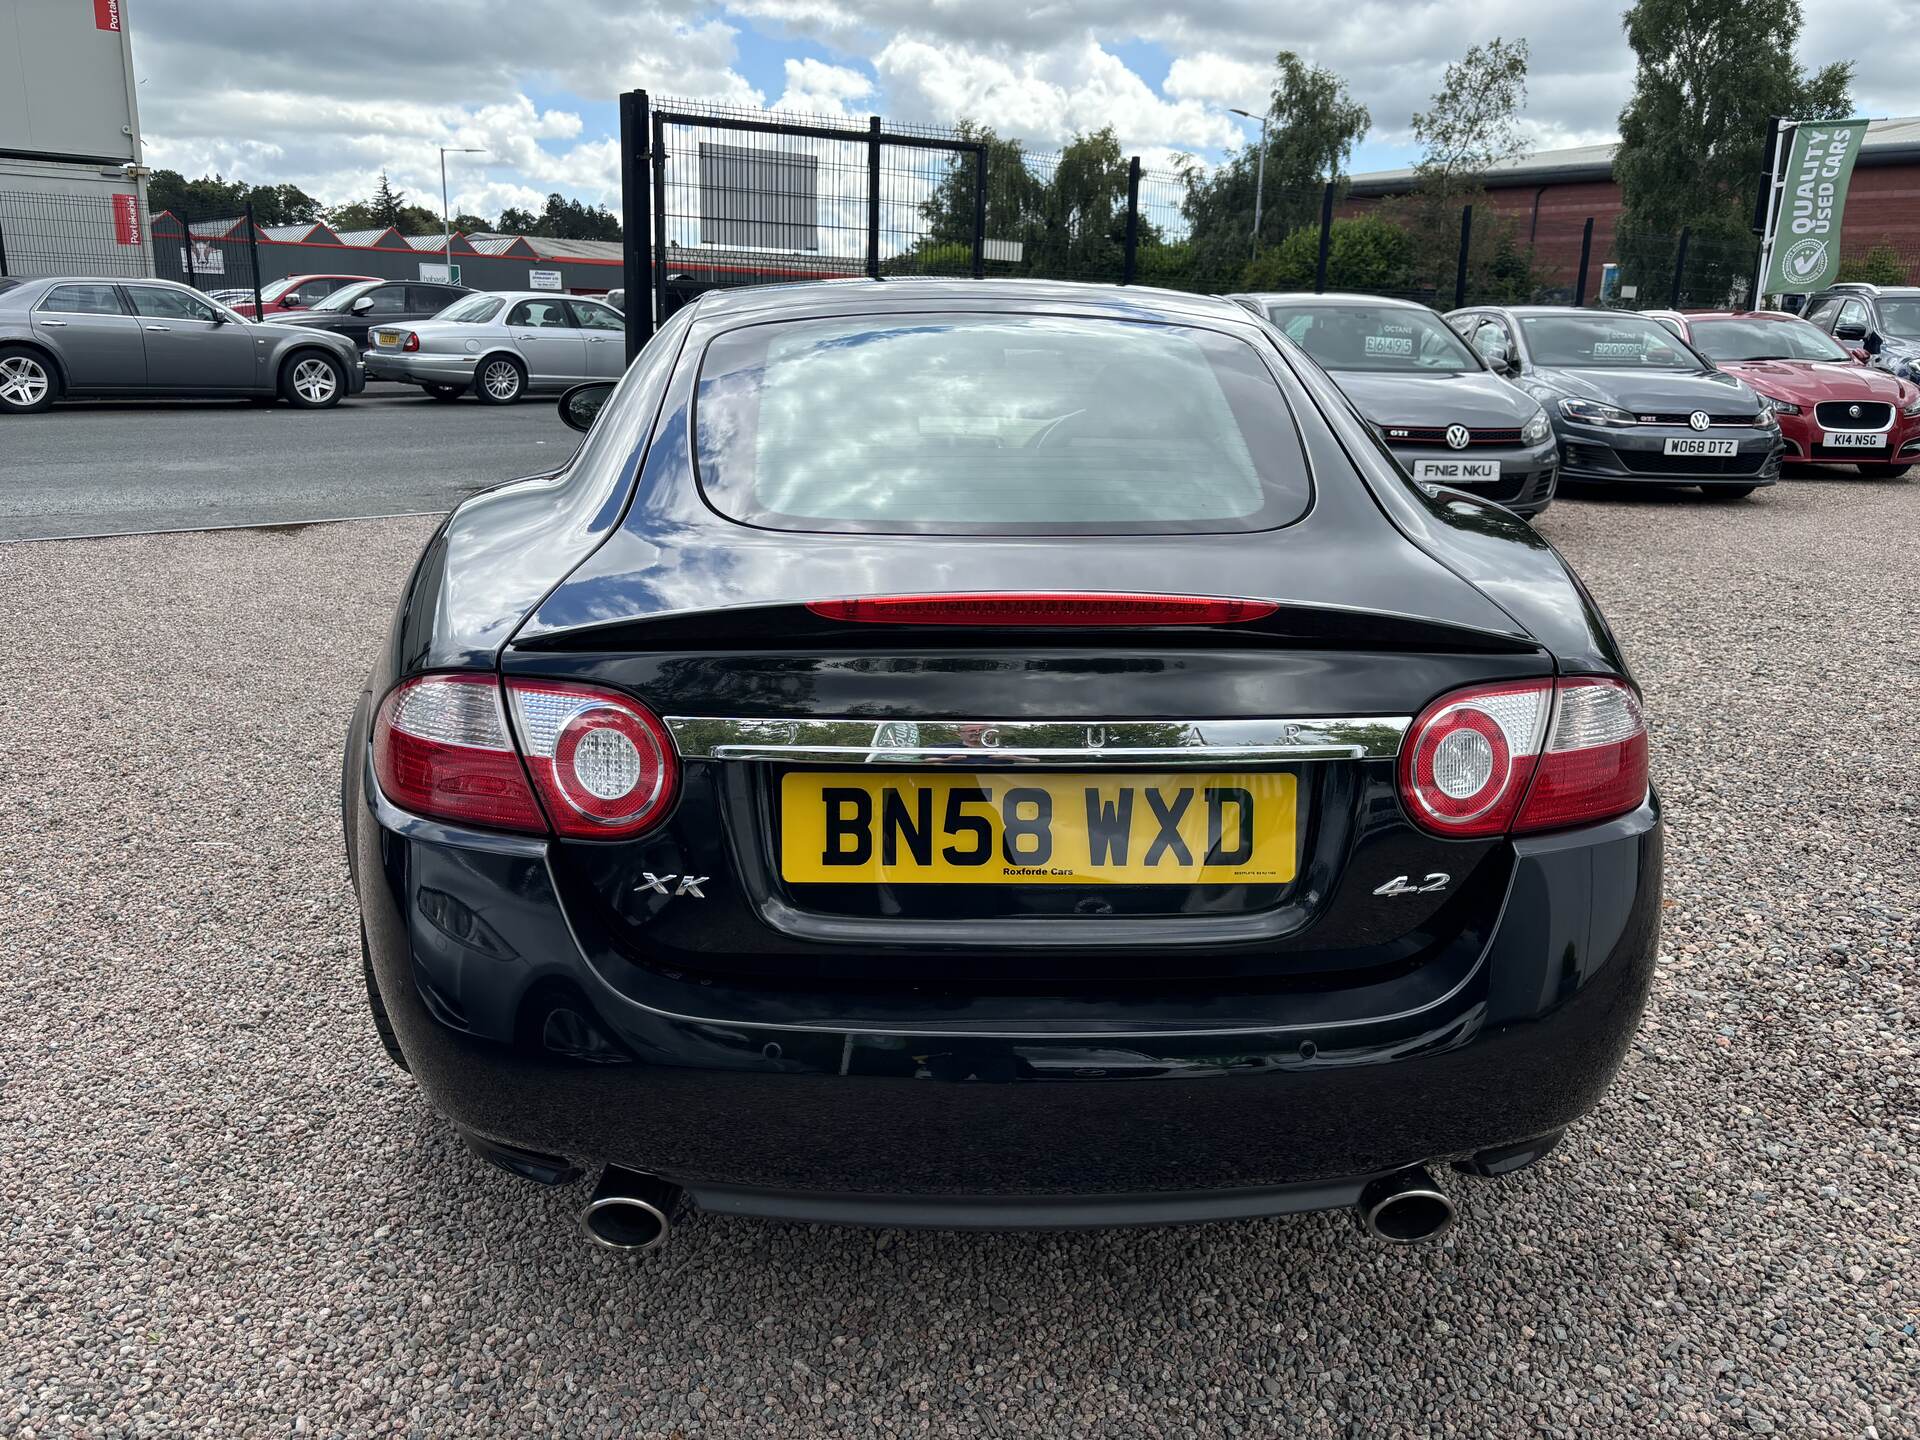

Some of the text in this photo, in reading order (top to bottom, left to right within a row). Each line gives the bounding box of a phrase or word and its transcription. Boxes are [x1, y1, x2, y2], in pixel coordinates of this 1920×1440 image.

[1791, 130, 1829, 235] QUALITY
[1815, 128, 1851, 234] USED CARS
[127, 195, 140, 244] Portakabin
[1384, 324, 1413, 334] OCTANE
[1366, 337, 1412, 353] £6495
[1595, 343, 1642, 355] £20995
[1671, 440, 1734, 454] WO68 DTZ
[1834, 434, 1877, 446] K14 NSG
[1424, 464, 1492, 477] FN12 NKU
[821, 786, 1254, 867] BN58 WXD
[1003, 868, 1073, 876] Roxforde Cars
[633, 871, 710, 899] XK
[1371, 872, 1452, 897] 4.2
